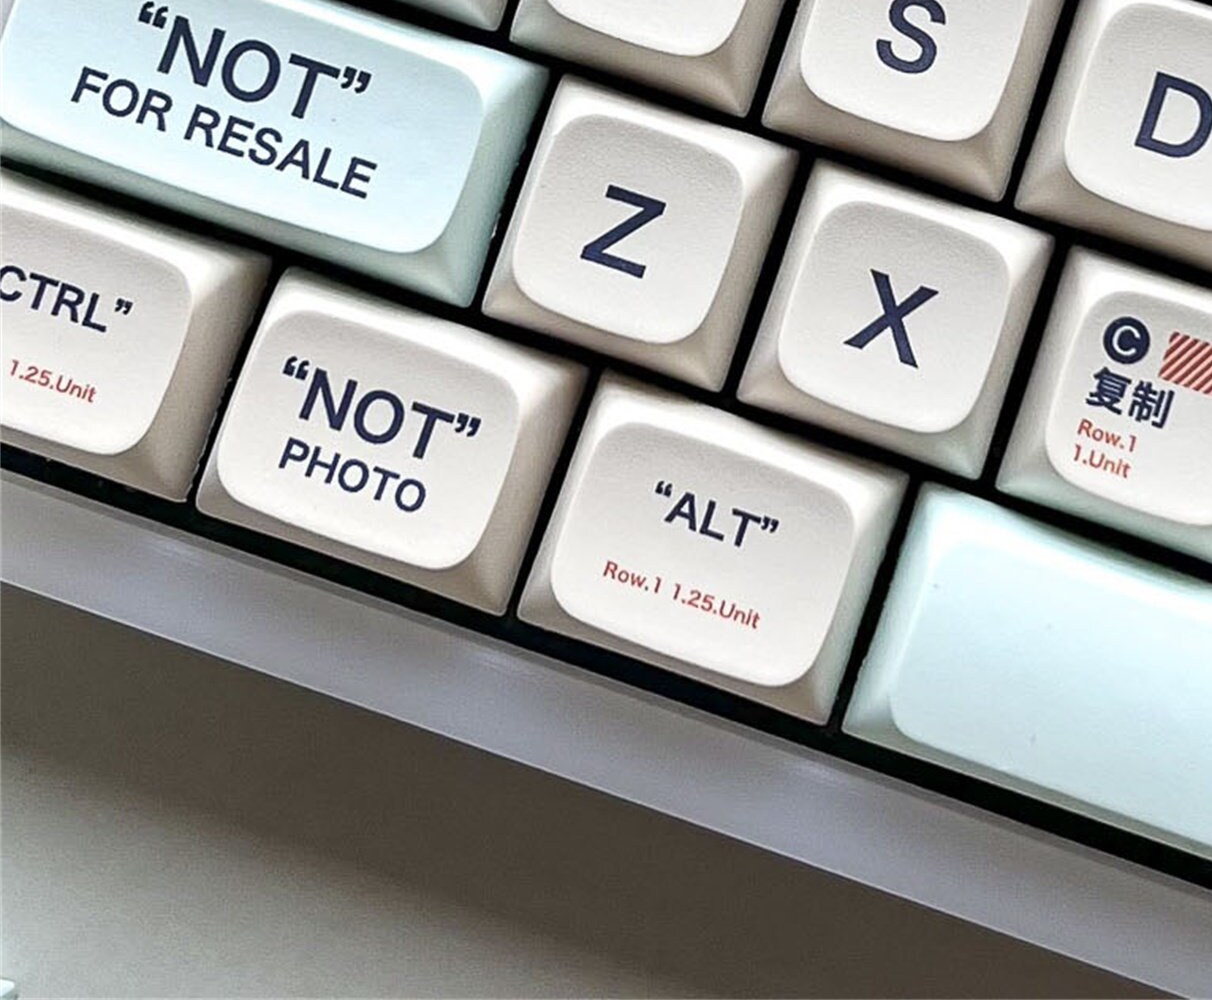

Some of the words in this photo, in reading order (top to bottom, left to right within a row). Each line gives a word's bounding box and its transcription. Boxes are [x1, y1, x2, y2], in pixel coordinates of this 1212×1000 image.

[71, 67, 172, 131] FOR
[184, 105, 377, 199] RESALE
[581, 185, 666, 278] Z
[844, 269, 938, 368] X
[8, 359, 96, 404] 1.25.Unit
[1085, 366, 1175, 429] 复制
[1073, 444, 1131, 479] 1.Unit
[1077, 418, 1137, 453] Row.1
[279, 439, 426, 513] PHOTO
[603, 559, 662, 593] Row.1
[674, 583, 762, 629] 1.25.Unit
